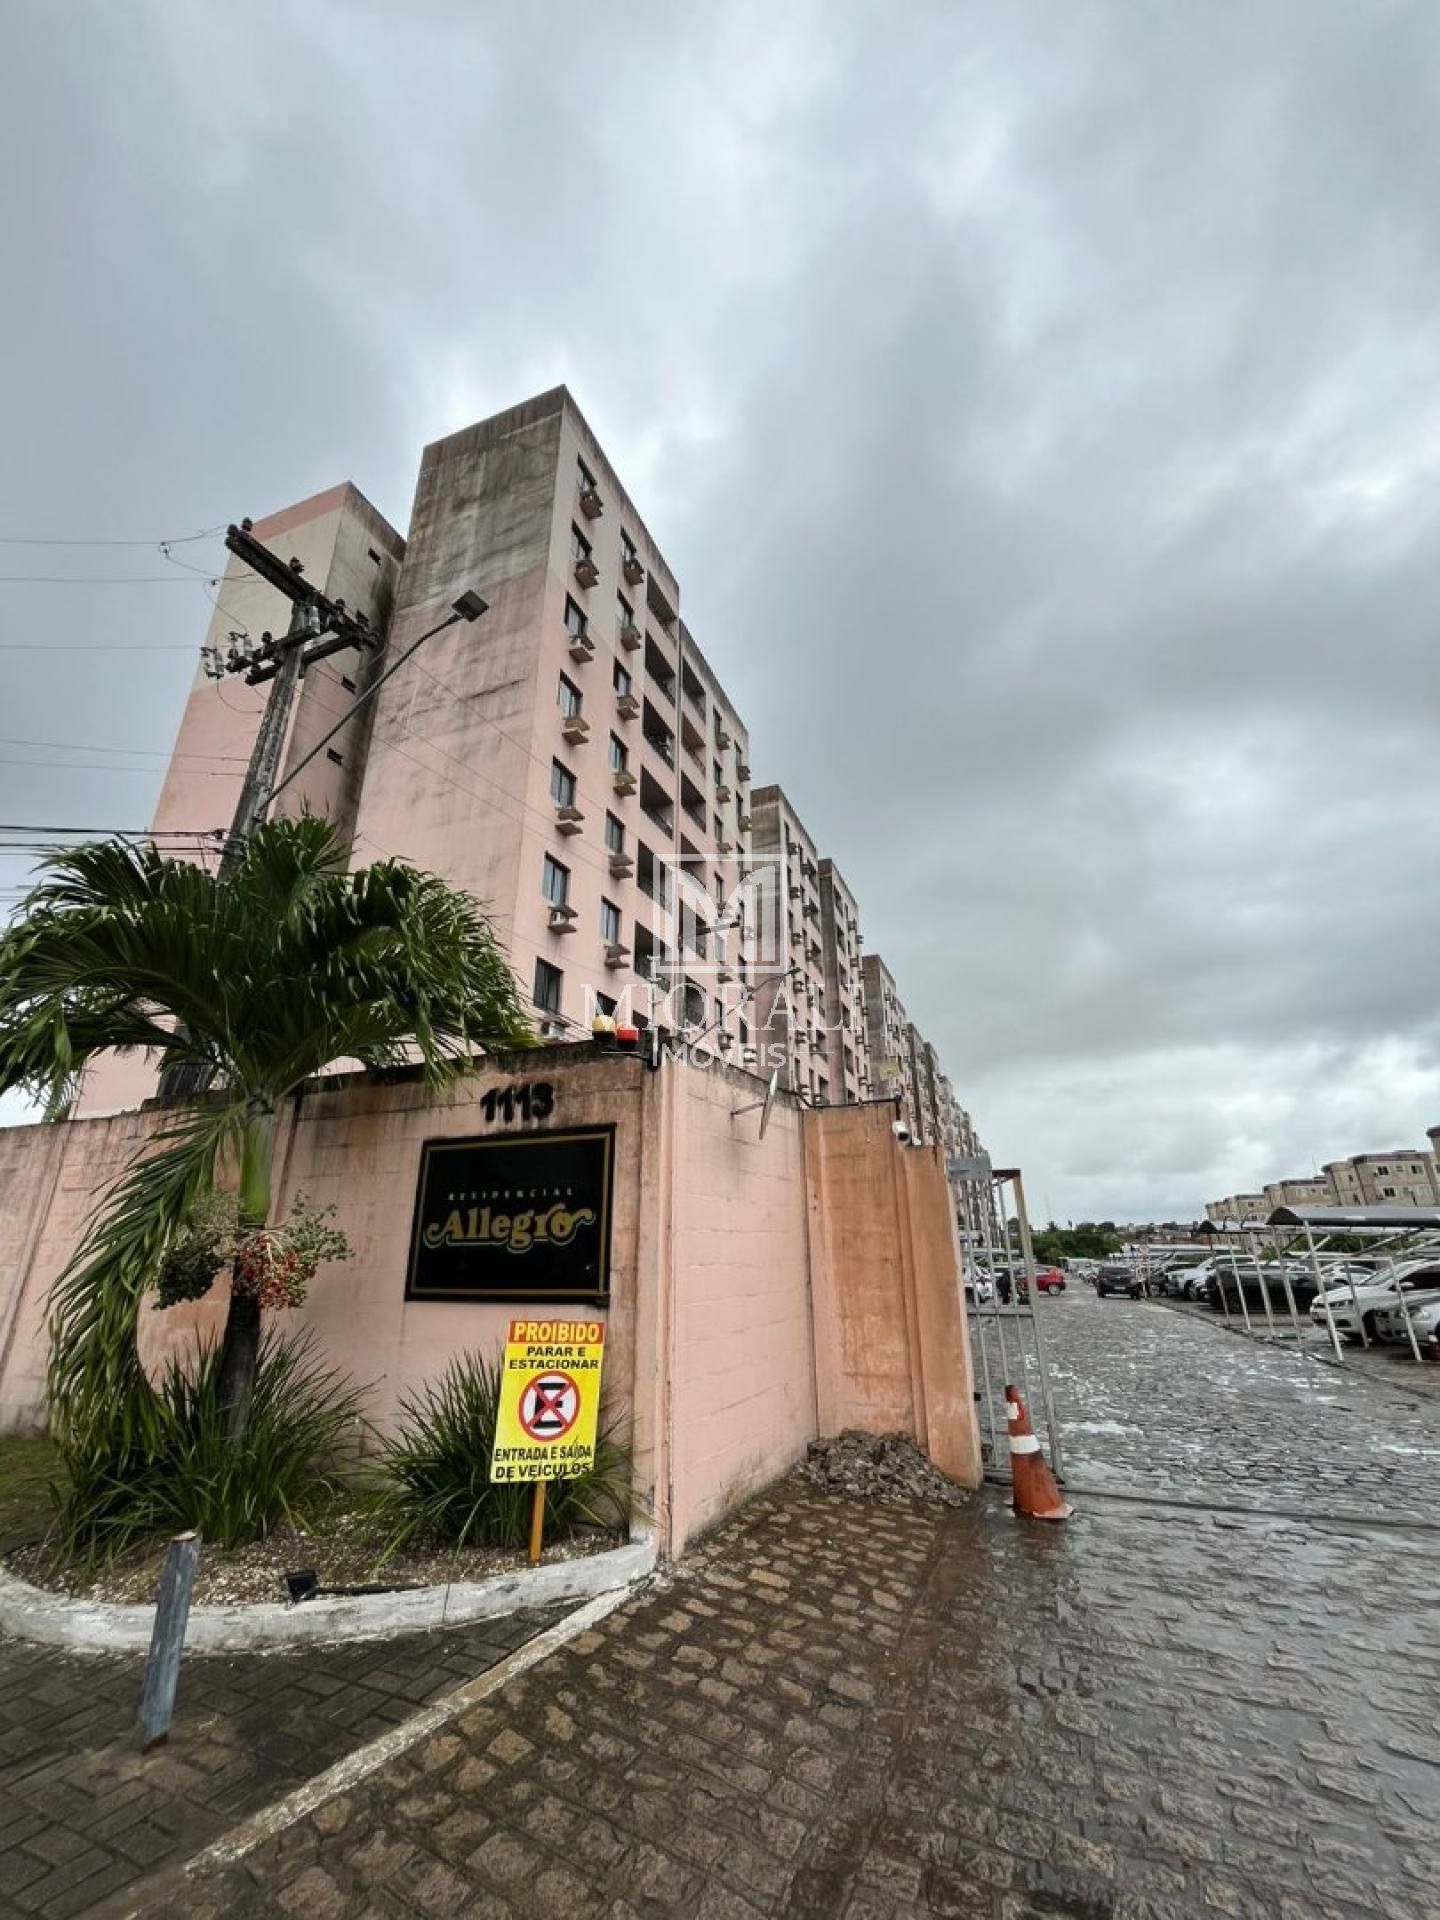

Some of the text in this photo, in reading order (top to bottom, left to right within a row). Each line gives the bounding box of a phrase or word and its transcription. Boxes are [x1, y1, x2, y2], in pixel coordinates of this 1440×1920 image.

[424, 1202, 596, 1254] Allegro
[513, 1322, 600, 1343] PROIBIDO
[527, 1346, 586, 1357] PARAR E
[509, 1359, 599, 1370] ESTACIONAR
[495, 1447, 548, 1462] ENTRADA
[550, 1446, 558, 1460] E
[495, 1465, 515, 1478] DE
